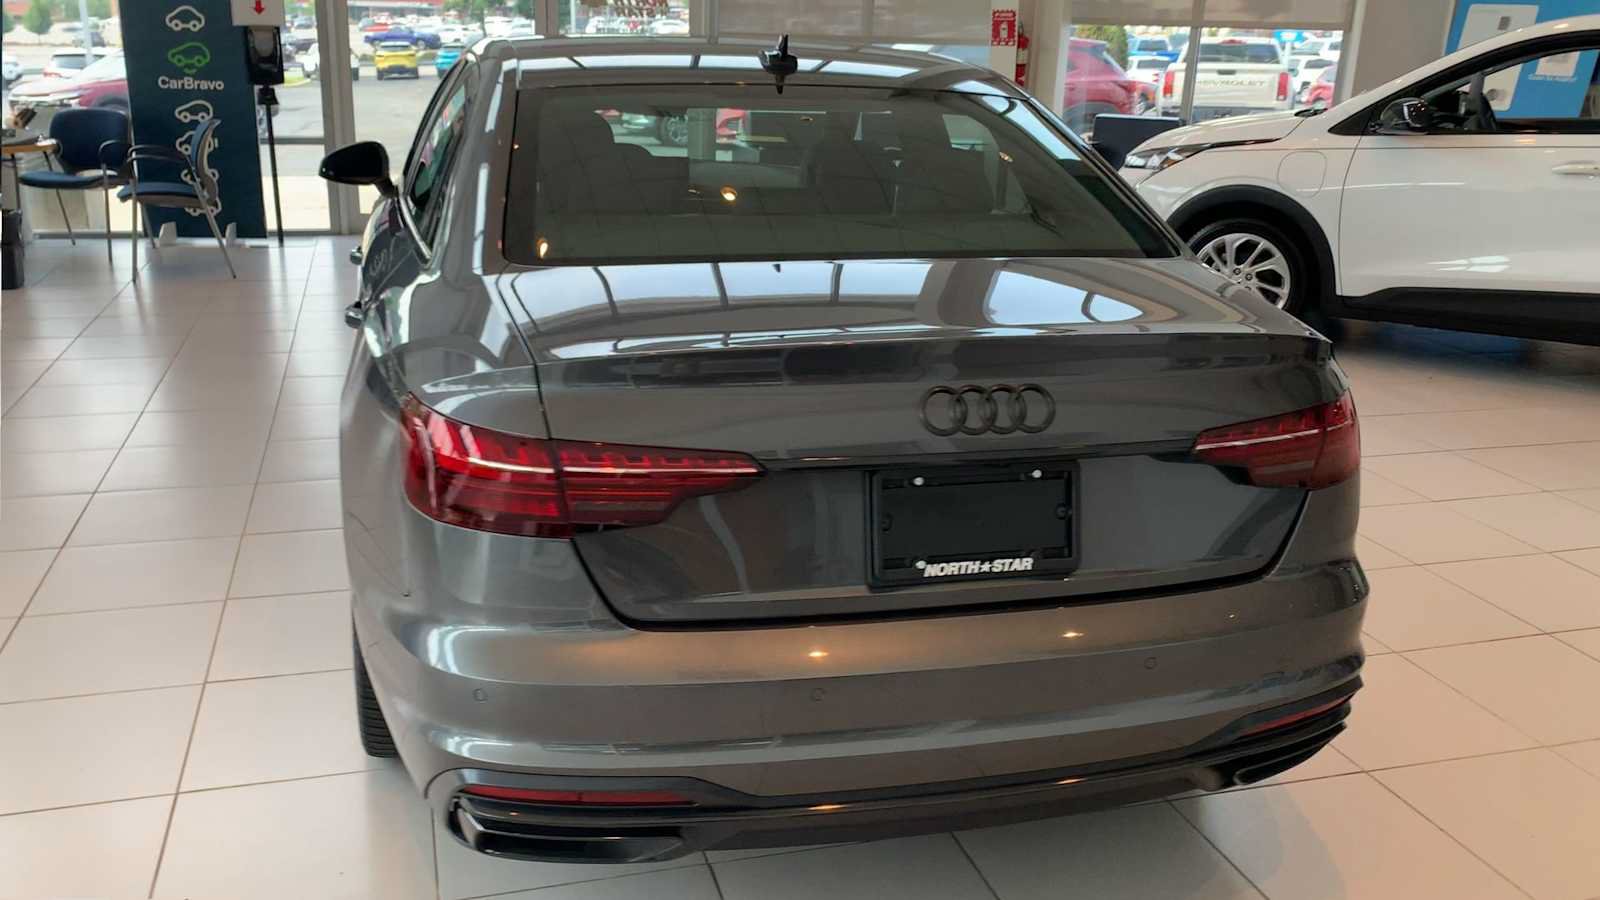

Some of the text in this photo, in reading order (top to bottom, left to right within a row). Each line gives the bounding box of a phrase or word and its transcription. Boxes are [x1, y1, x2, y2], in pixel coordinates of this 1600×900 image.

[157, 76, 224, 90] CarBravo
[923, 558, 1034, 577] NORTH STAR
